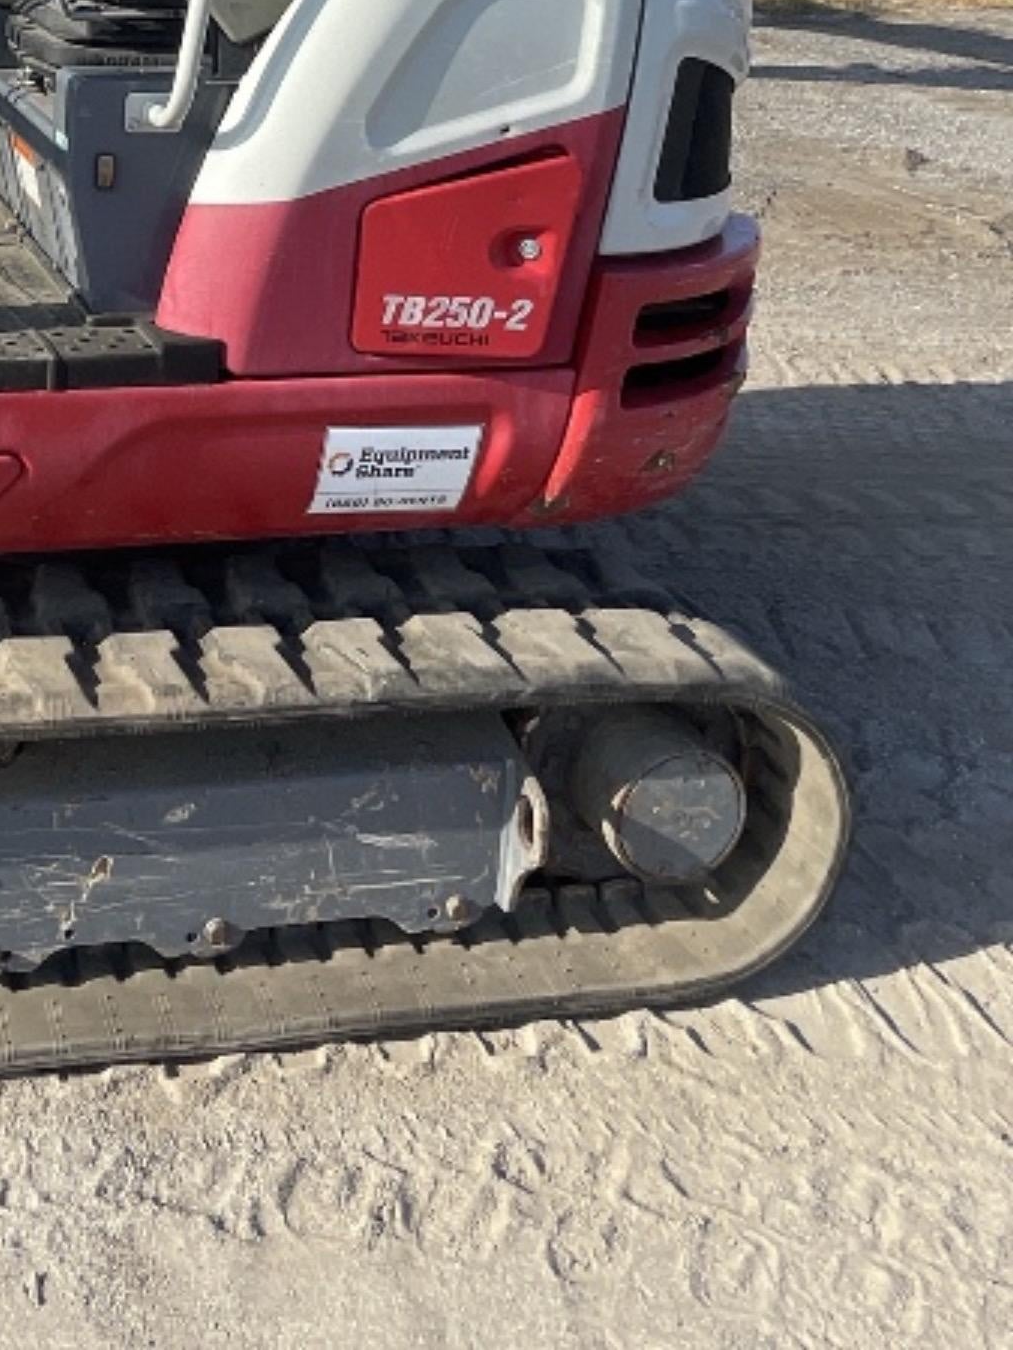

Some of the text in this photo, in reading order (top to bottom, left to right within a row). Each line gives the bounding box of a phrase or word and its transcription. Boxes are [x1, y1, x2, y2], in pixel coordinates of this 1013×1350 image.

[382, 294, 535, 331] TB250-2
[380, 329, 490, 347] TAKEUCHI
[358, 446, 471, 465] Equipment
[355, 464, 416, 479] Share
